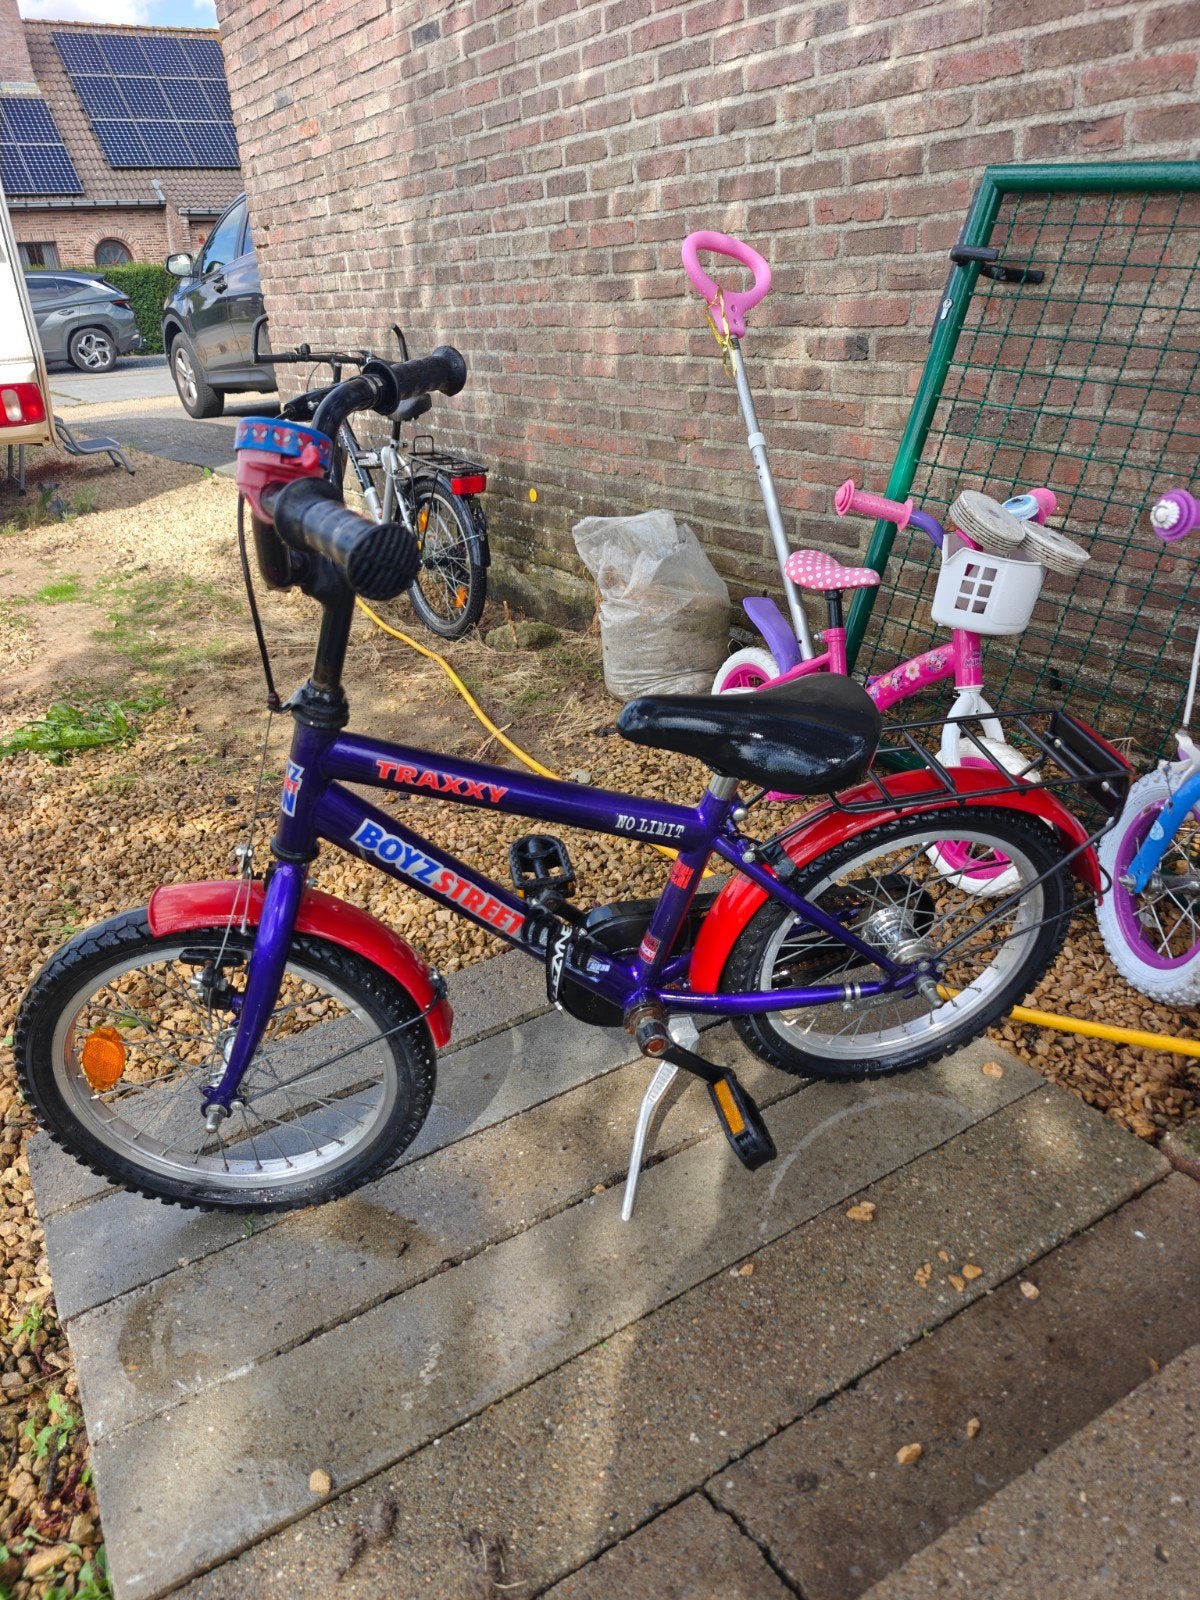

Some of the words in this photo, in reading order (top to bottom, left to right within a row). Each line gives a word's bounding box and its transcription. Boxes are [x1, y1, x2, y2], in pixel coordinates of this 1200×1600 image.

[376, 759, 509, 804] TRAXXY
[615, 814, 636, 831] NO
[636, 818, 685, 839] LIMIT
